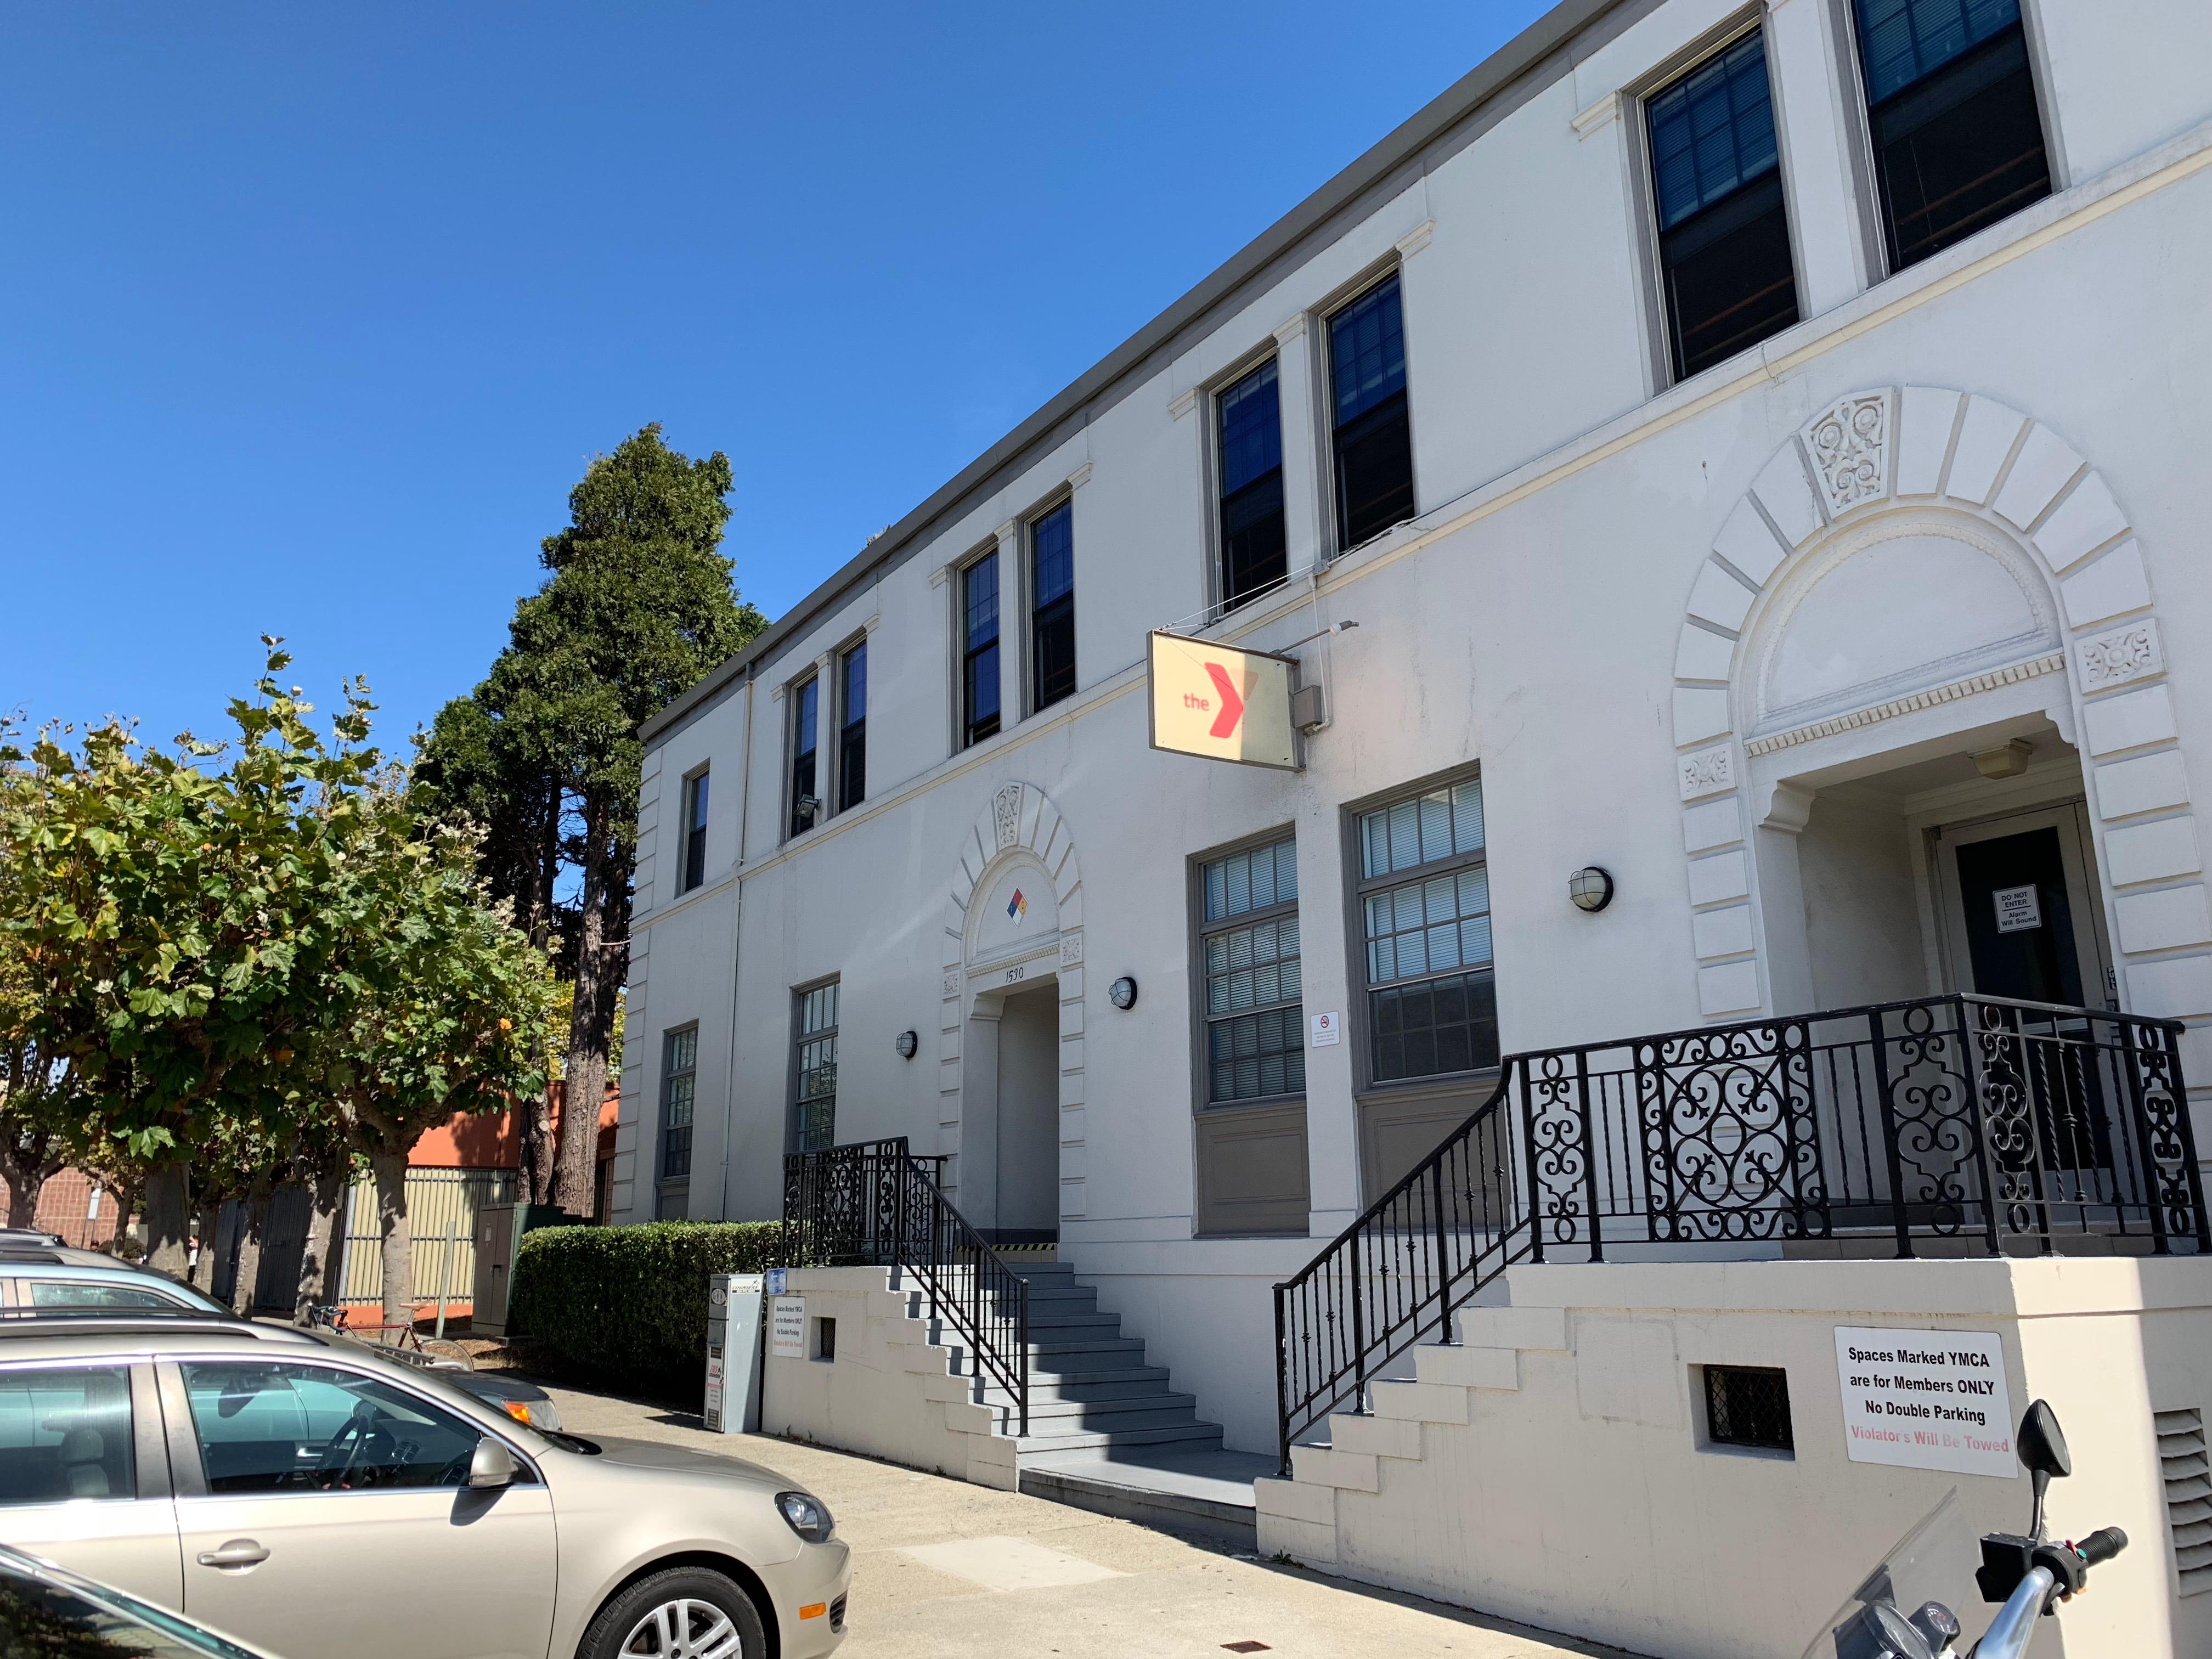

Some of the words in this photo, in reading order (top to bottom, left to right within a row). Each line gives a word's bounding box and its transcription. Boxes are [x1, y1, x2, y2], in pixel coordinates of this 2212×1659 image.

[1183, 692, 1210, 712] the
[2005, 899, 2027, 908] ENTER
[2016, 916, 2037, 924] Sound
[1006, 967, 1024, 983] 1530
[1848, 1346, 1894, 1363] Spaces
[1897, 1349, 1945, 1365] Marked
[1948, 1351, 1990, 1367] YMCA
[1850, 1375, 1870, 1387] are
[1873, 1374, 1891, 1388] for
[1894, 1375, 1954, 1392] Members
[1957, 1379, 1994, 1395] ONLY
[1865, 1400, 1882, 1414] No
[1886, 1401, 1930, 1418] Double
[1933, 1405, 1985, 1426] Parking
[1914, 1431, 1939, 1446] Will
[1943, 1435, 1960, 1448] Be
[1963, 1435, 2009, 1453] Towed
